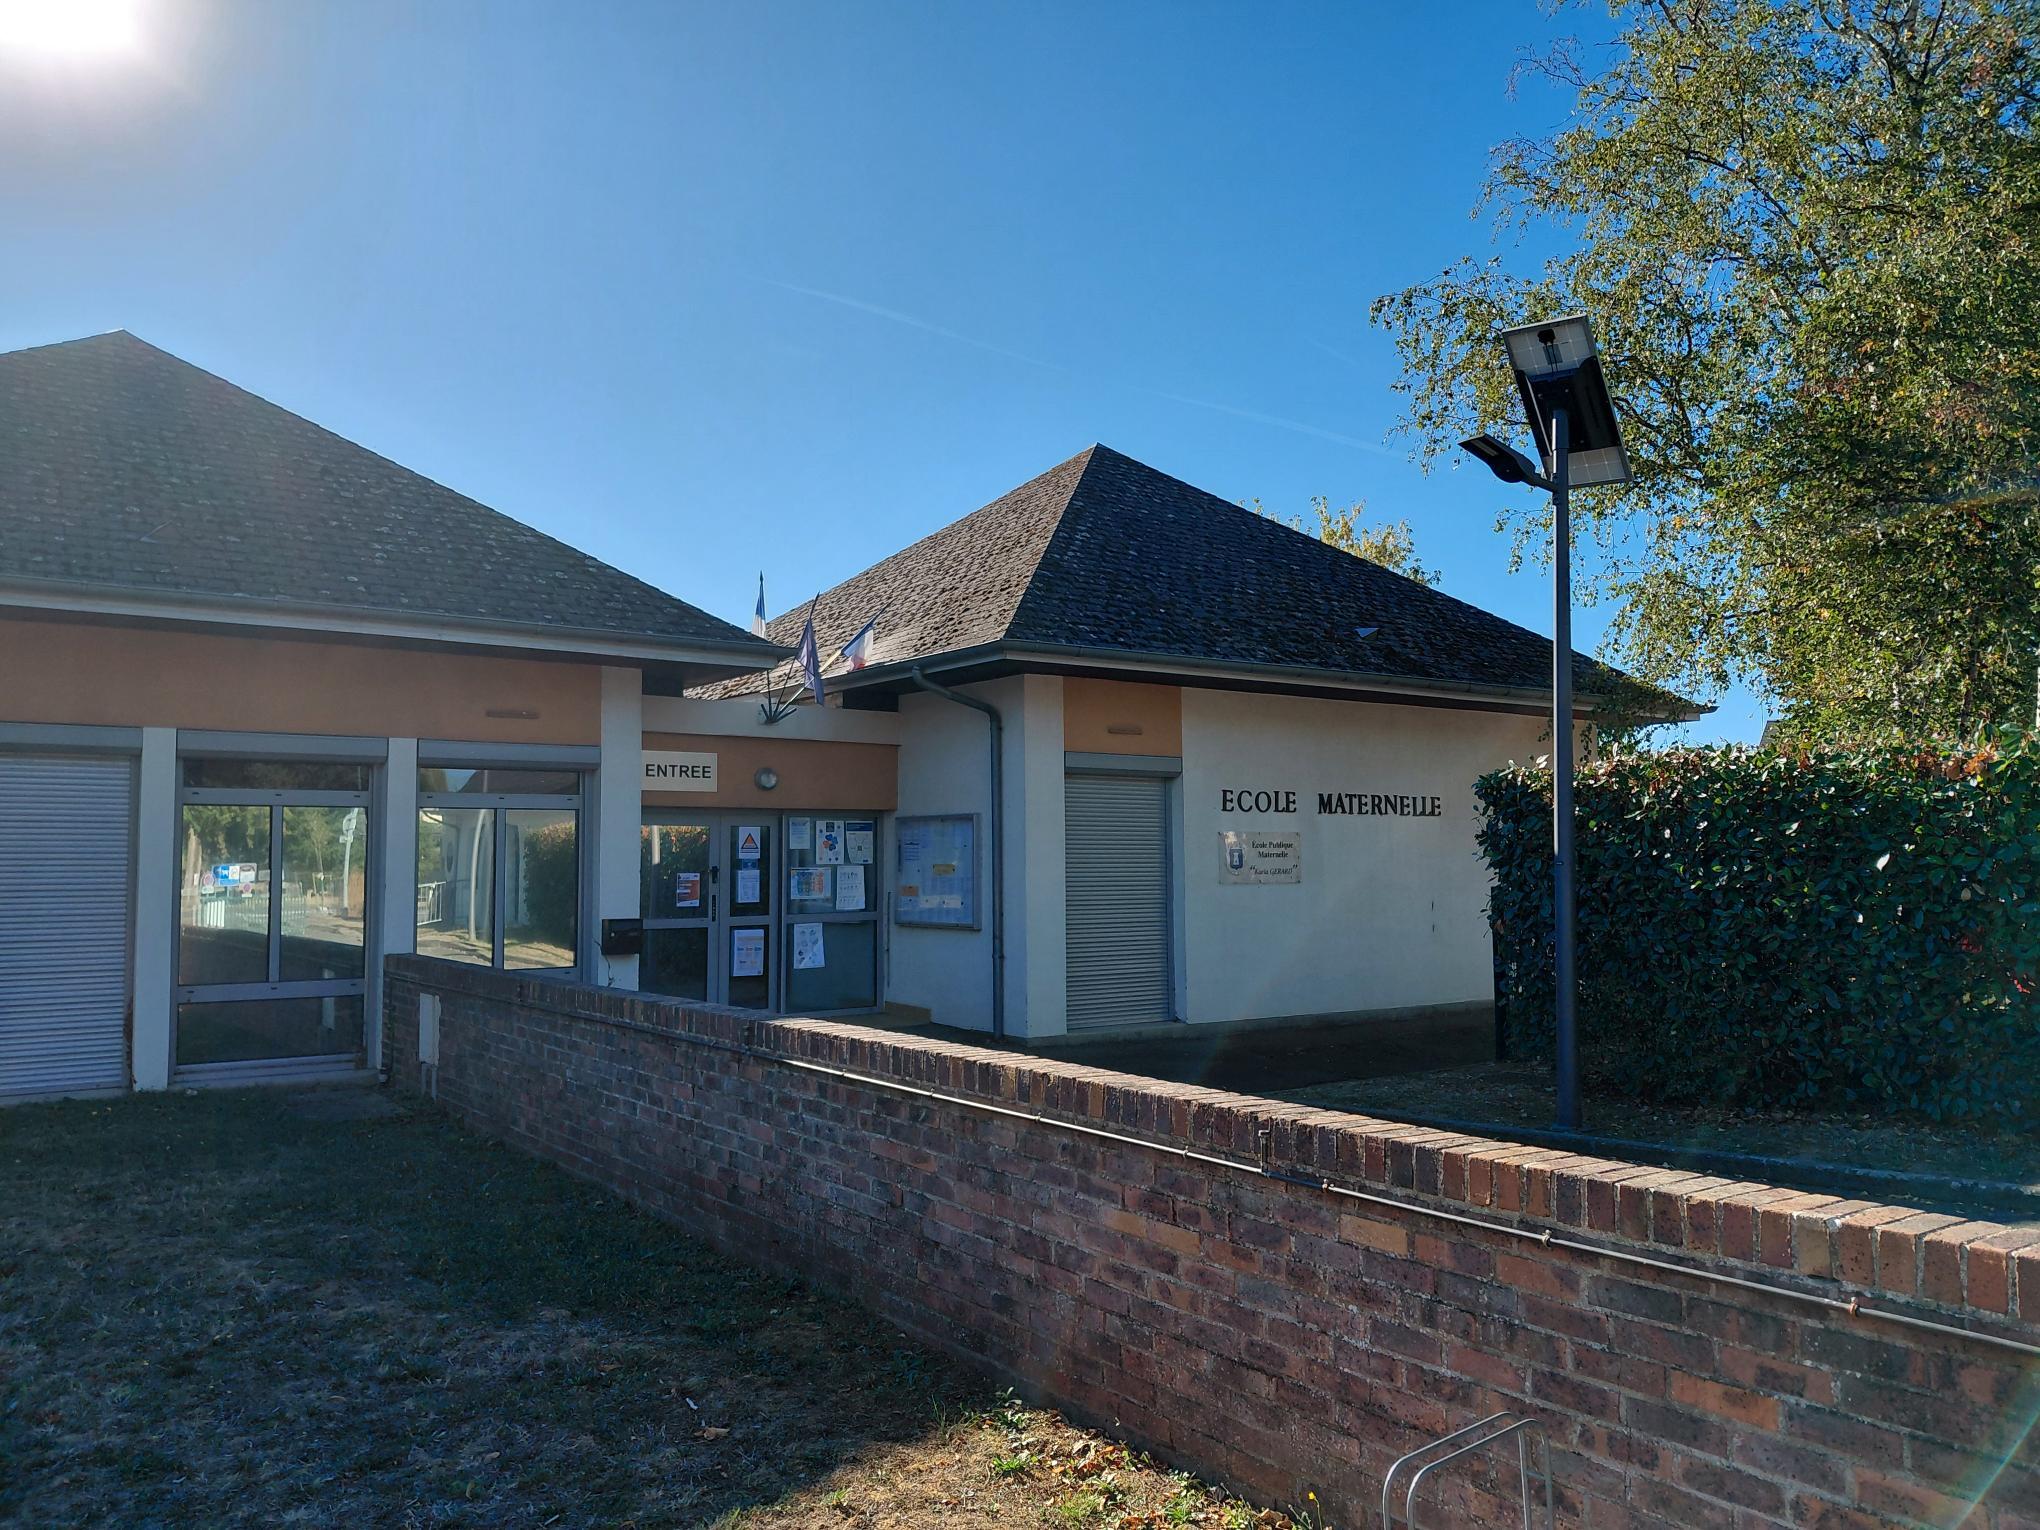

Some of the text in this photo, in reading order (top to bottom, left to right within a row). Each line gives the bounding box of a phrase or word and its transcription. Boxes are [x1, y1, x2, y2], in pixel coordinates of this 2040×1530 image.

[645, 763, 712, 779] ENTREE
[1221, 789, 1442, 817] ECOLE MATERNELLE
[1268, 841, 1294, 850] Publique
